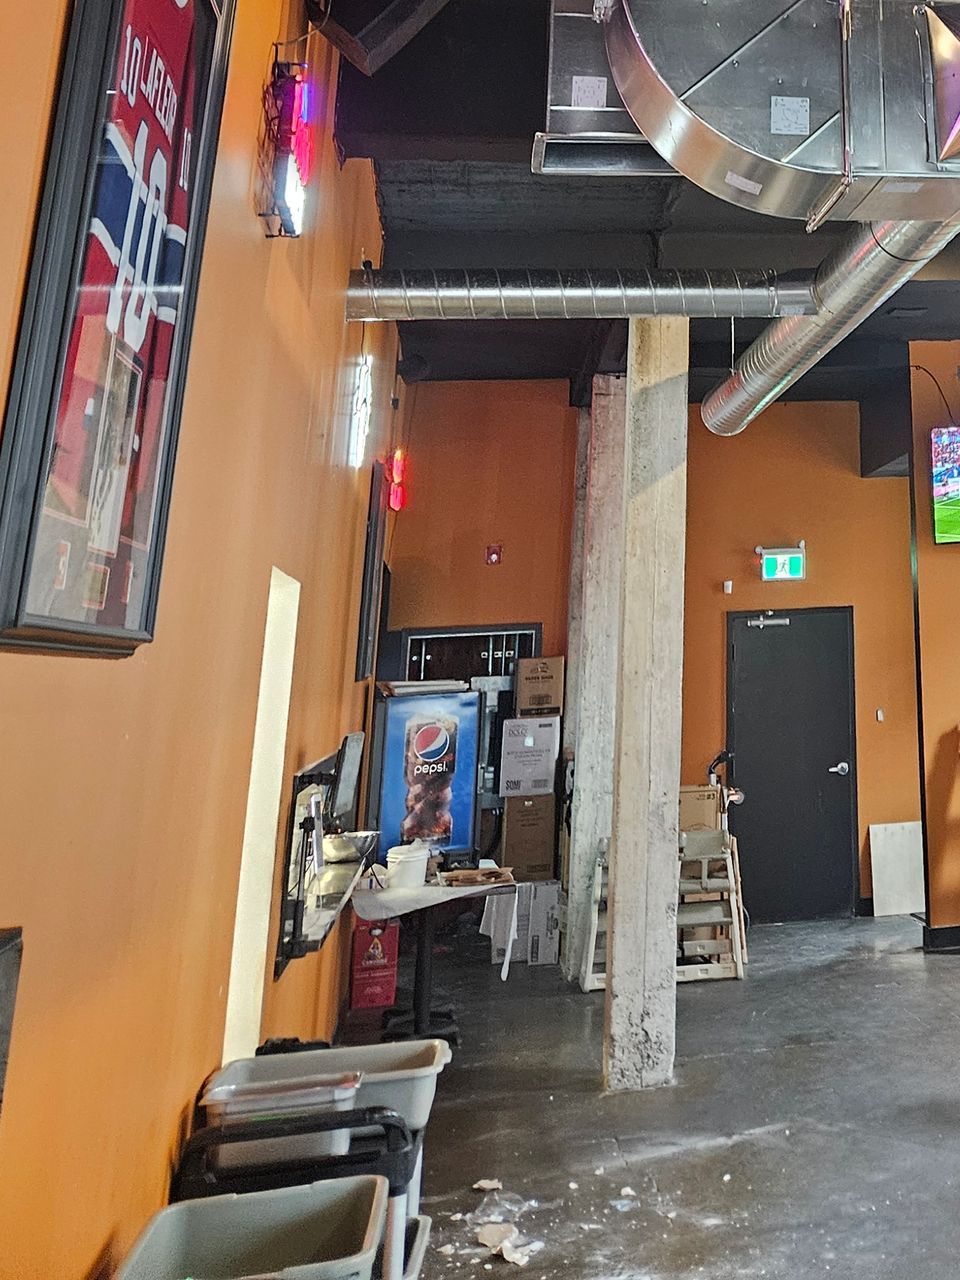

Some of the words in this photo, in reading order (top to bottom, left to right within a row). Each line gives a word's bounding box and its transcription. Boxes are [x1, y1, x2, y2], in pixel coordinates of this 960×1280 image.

[120, 23, 142, 108] 10
[106, 119, 167, 352] 10
[414, 761, 446, 777] pepsi
